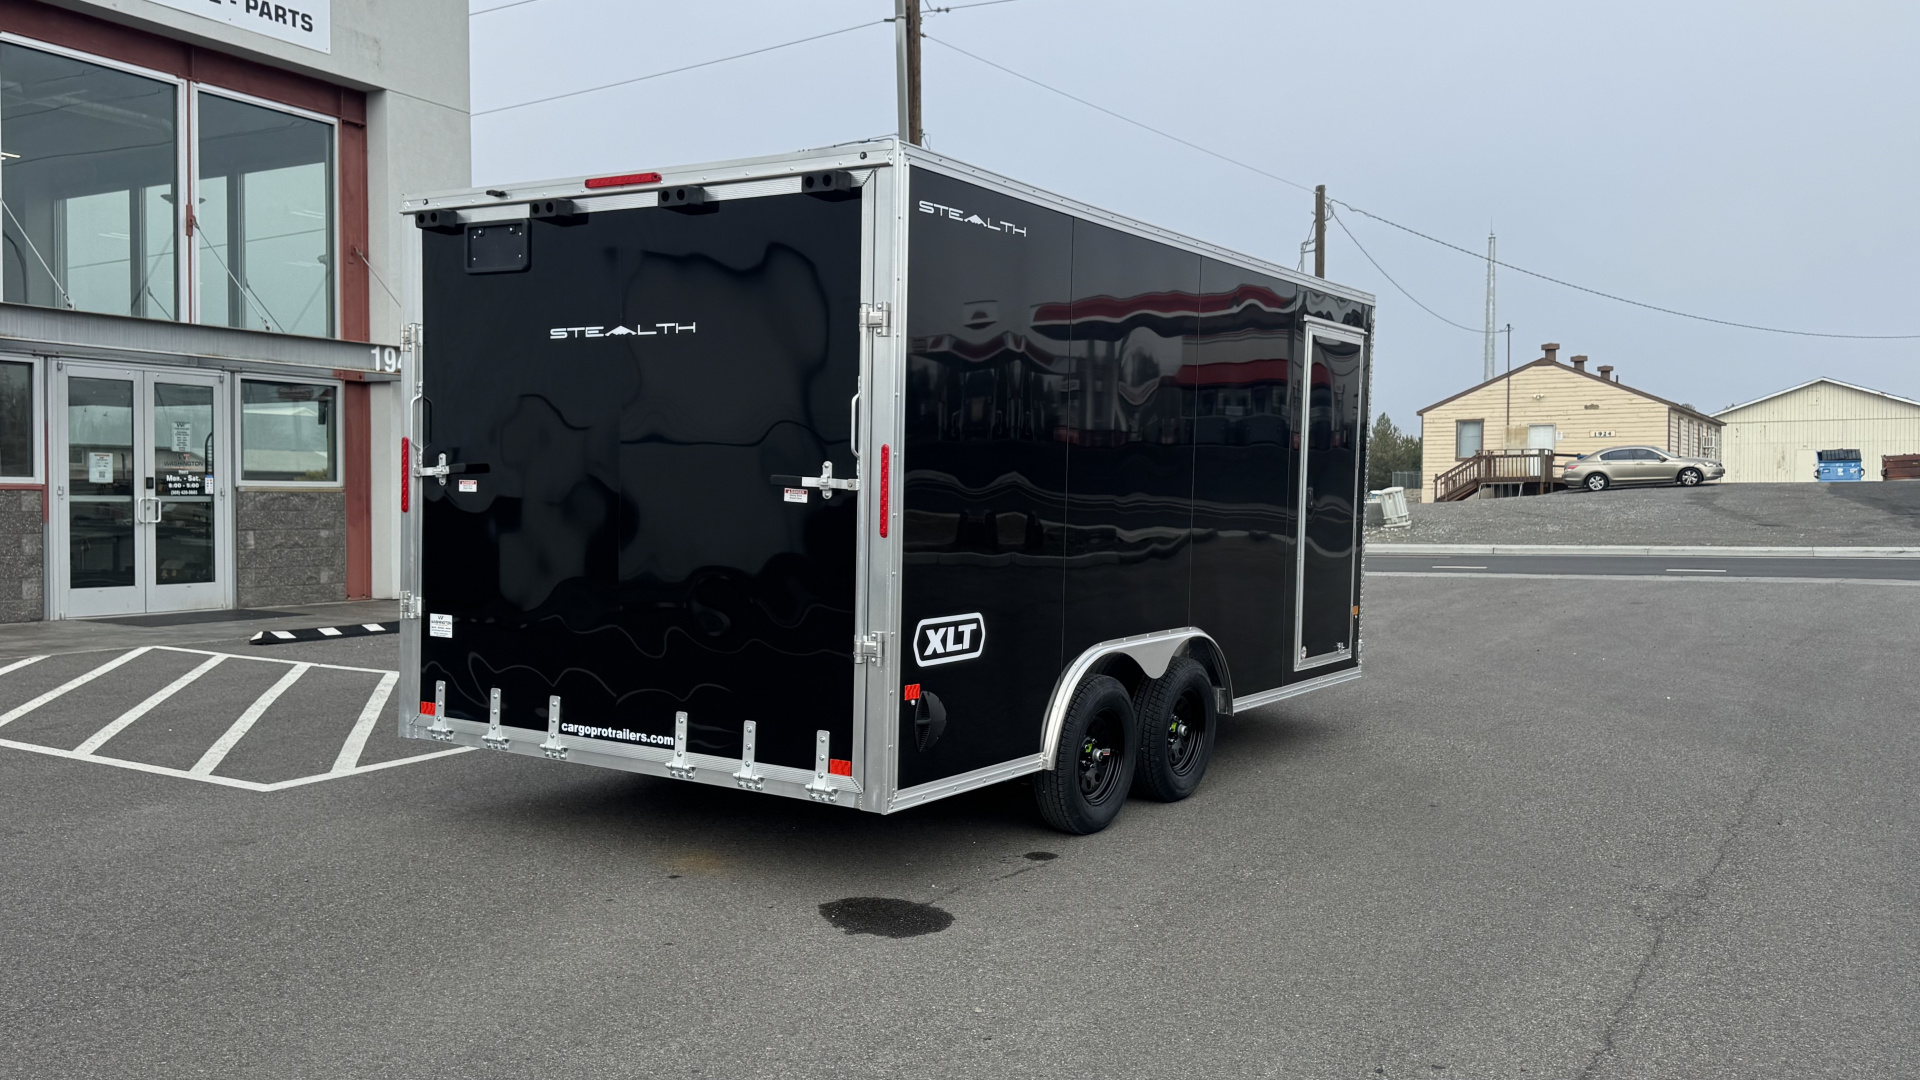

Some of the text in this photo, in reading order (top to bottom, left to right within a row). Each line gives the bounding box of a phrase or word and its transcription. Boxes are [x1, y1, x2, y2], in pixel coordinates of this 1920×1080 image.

[245, 0, 313, 33] PARTS
[919, 200, 1027, 238] STEALTH
[550, 321, 696, 340] STEALTH
[371, 345, 402, 373] 19
[166, 474, 182, 482] Mon.
[187, 474, 201, 482] Sat.
[923, 622, 978, 657] XLT
[561, 722, 674, 746] cargoprotrailers.com
